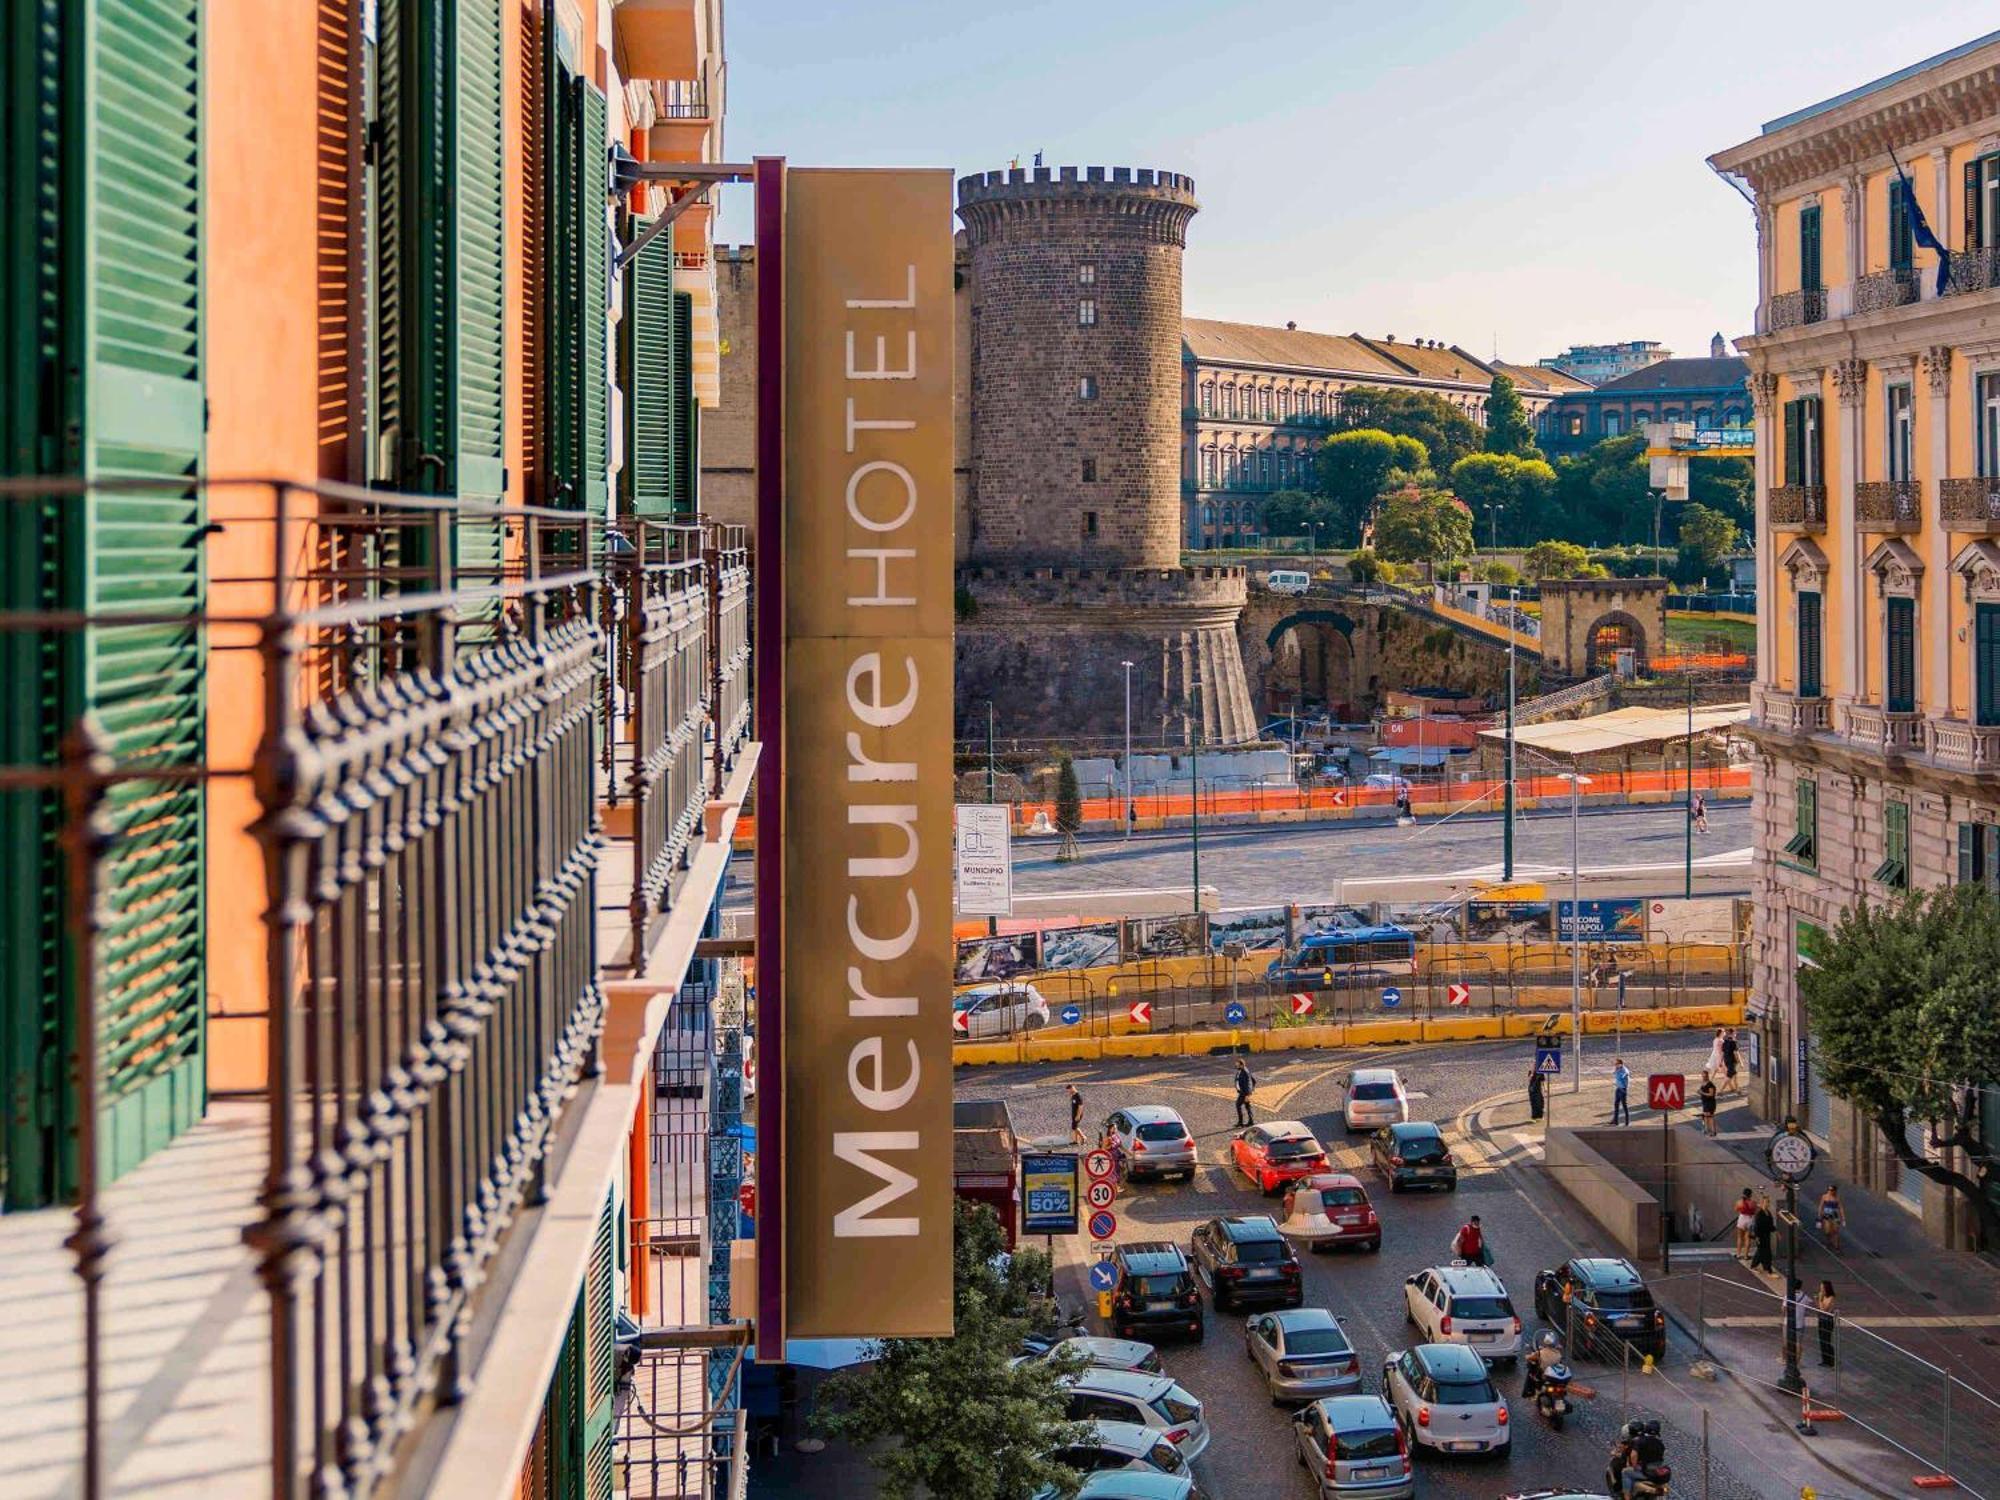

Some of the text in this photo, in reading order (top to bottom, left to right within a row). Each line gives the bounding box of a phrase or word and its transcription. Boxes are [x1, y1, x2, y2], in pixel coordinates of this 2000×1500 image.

[833, 264, 920, 1237] Mercure HOTEL
[1560, 916, 1601, 924] WECOME
[1653, 1082, 1681, 1102] M
[1094, 1187, 1110, 1202] 30
[1031, 1198, 1069, 1212] 50%
